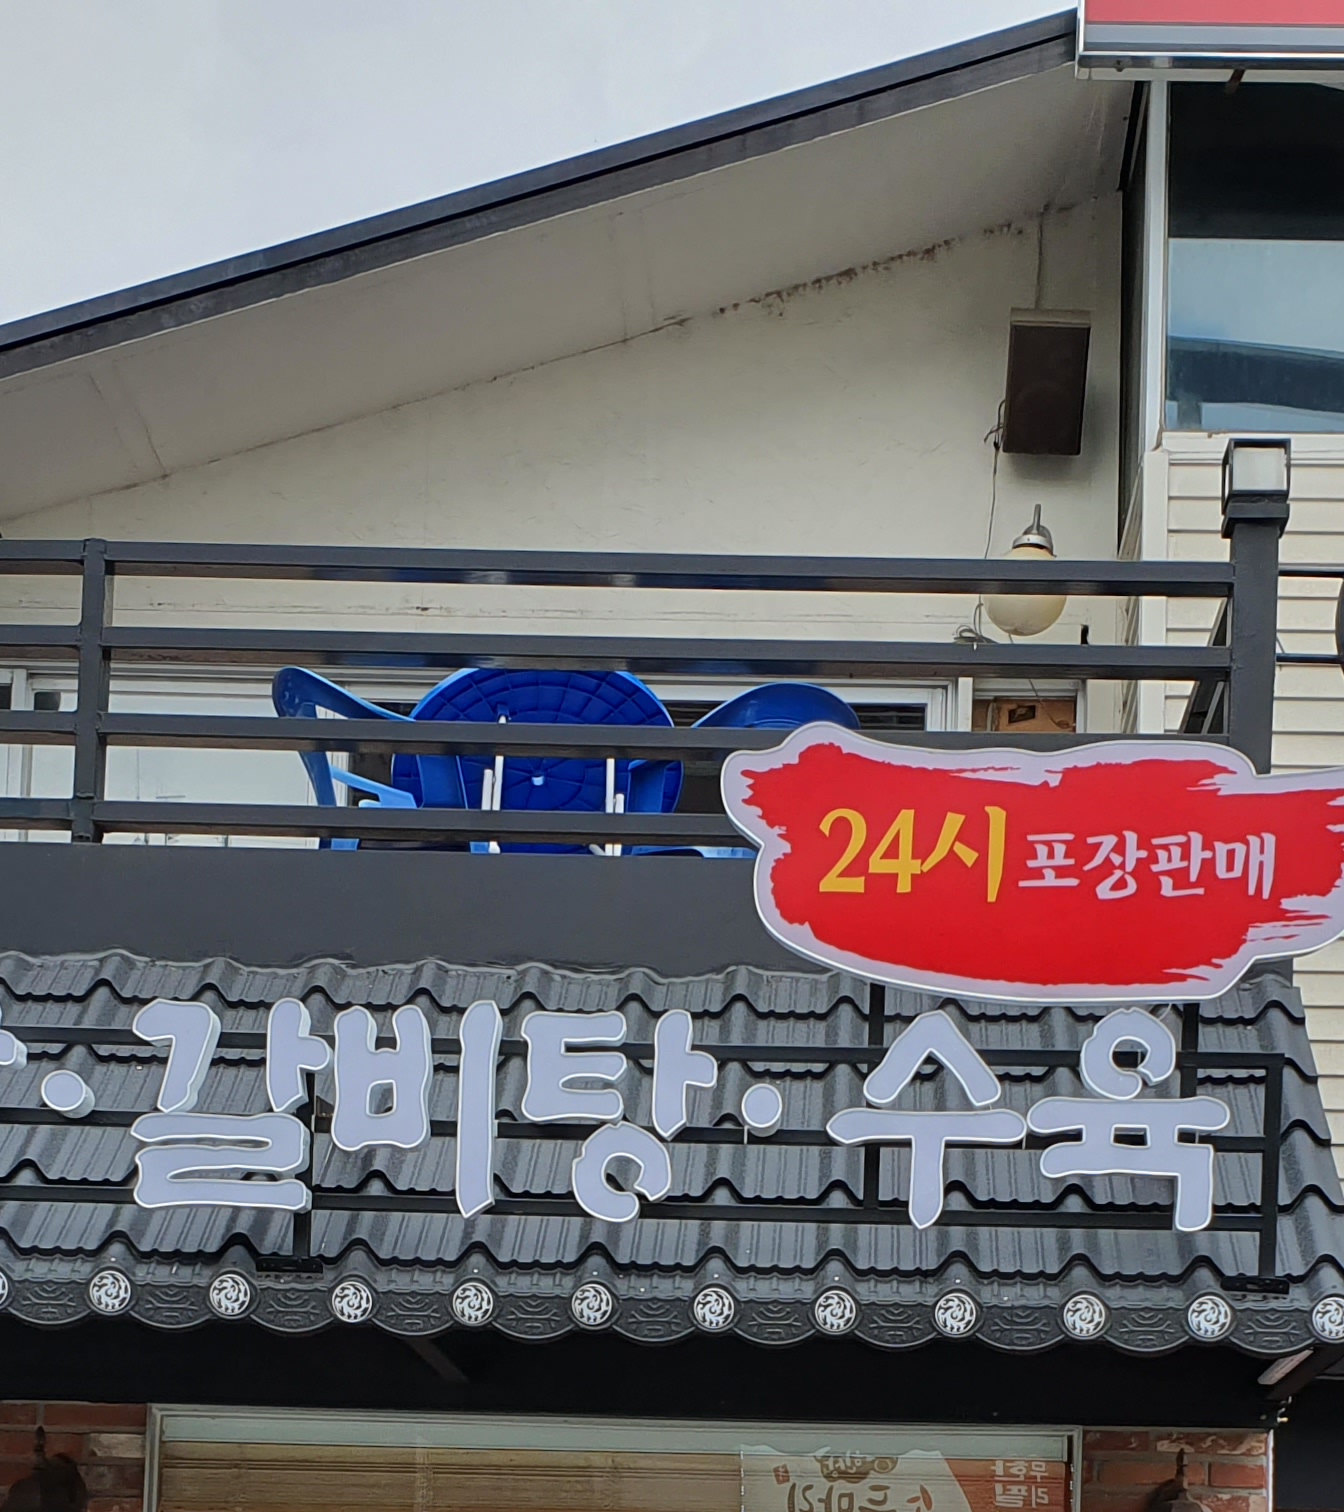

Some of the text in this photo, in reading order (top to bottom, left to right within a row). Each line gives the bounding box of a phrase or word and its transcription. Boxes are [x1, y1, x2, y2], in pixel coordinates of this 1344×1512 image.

[818, 806, 1276, 903] 24시 포장판매
[826, 1005, 1230, 1232] 수육
